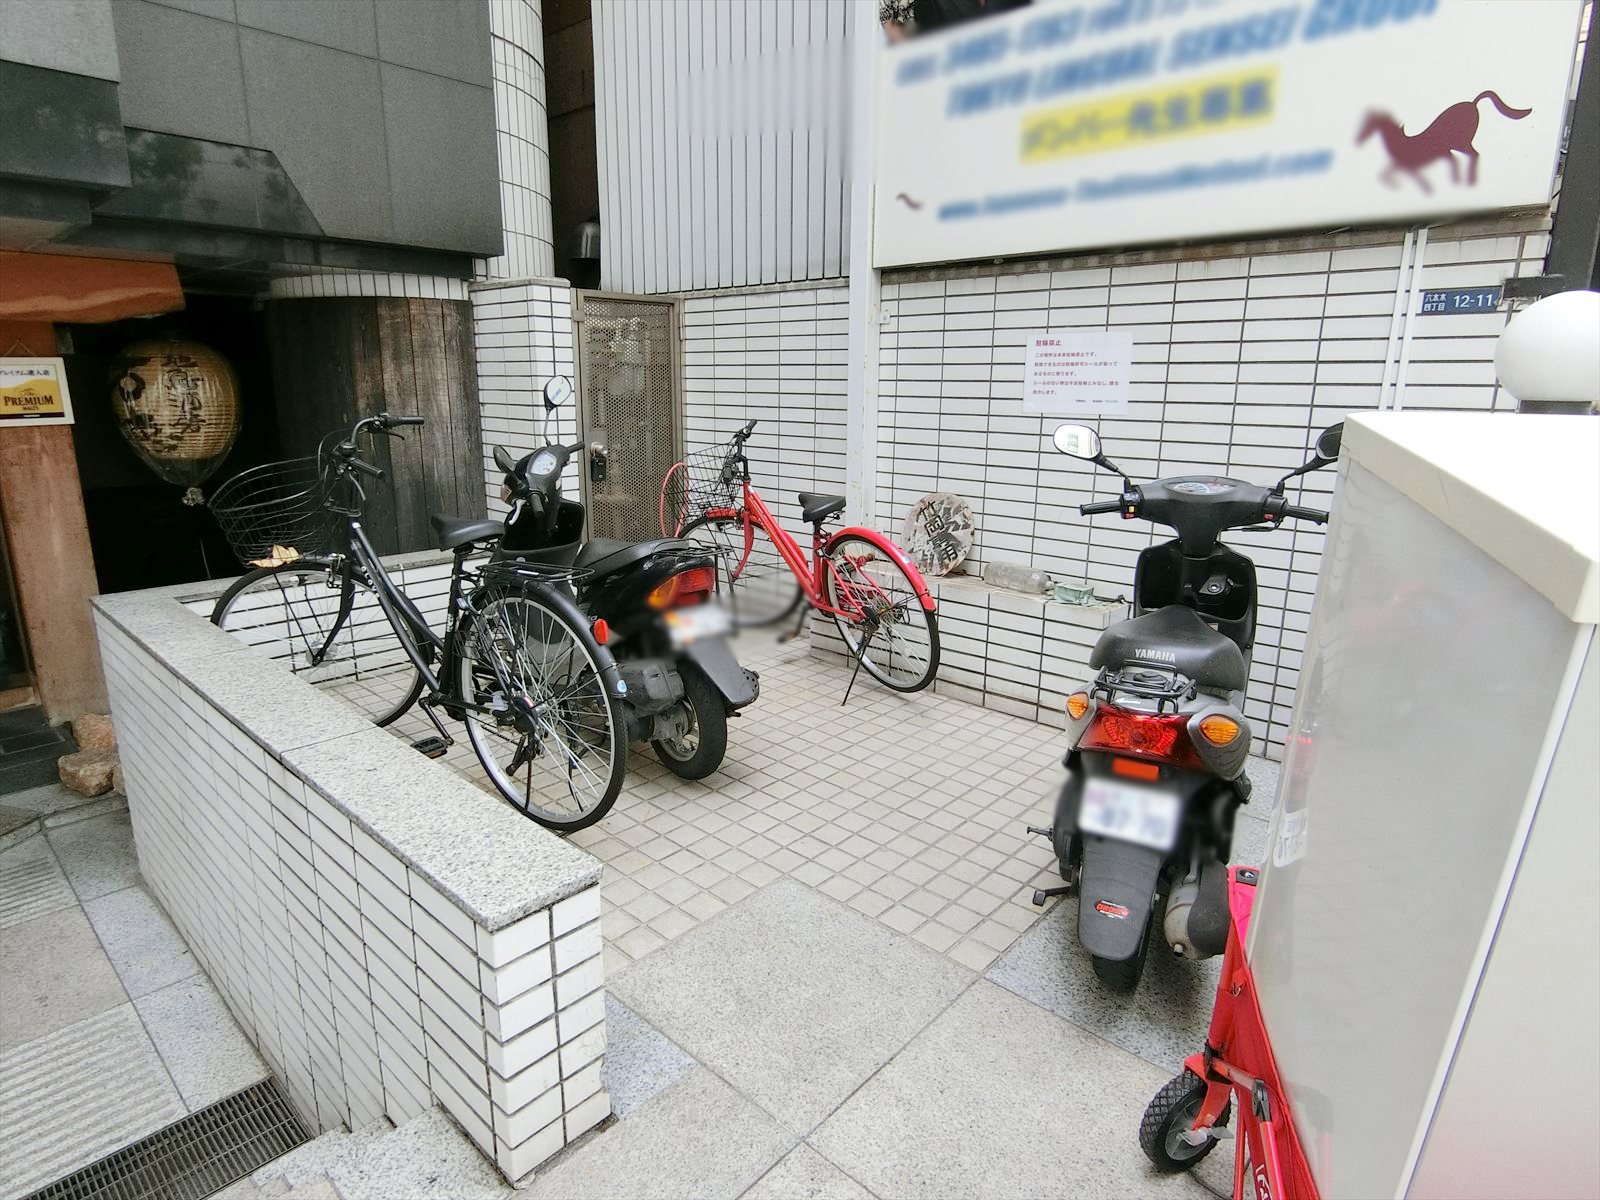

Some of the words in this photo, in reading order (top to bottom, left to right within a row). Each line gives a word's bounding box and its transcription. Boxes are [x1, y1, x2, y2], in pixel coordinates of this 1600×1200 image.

[1424, 293, 1447, 303] 六本木
[1453, 293, 1493, 308] 12-11
[1423, 302, 1445, 312] 四丁目
[4, 394, 54, 406] PREMIUM
[1134, 648, 1176, 663] YAMAHA
